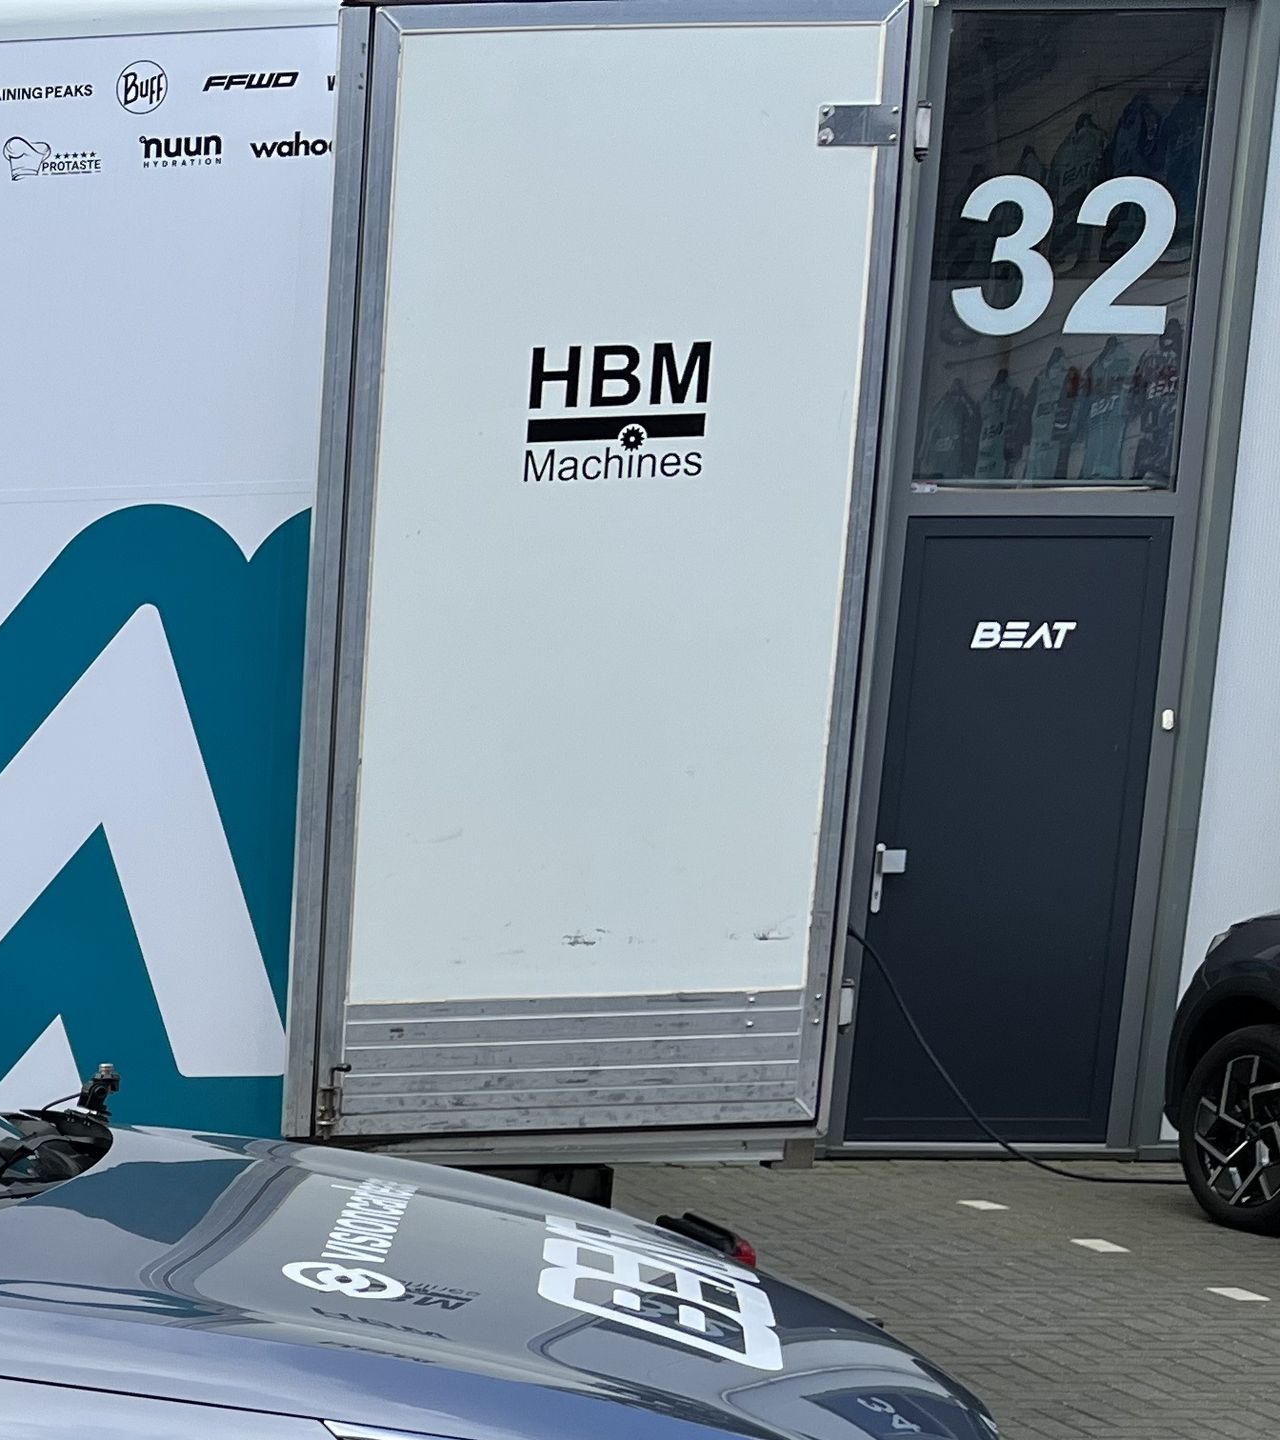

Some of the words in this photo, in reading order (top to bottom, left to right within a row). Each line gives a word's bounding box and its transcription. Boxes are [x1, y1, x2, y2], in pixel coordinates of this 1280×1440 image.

[44, 84, 93, 100] PEAKS
[141, 134, 222, 158] nuun
[41, 159, 101, 172] PROTASTE
[143, 158, 222, 168] HYDRATION
[951, 175, 1177, 336] 32
[528, 341, 712, 409] HBM
[523, 447, 703, 483] Machines
[970, 621, 1077, 650] BEAT
